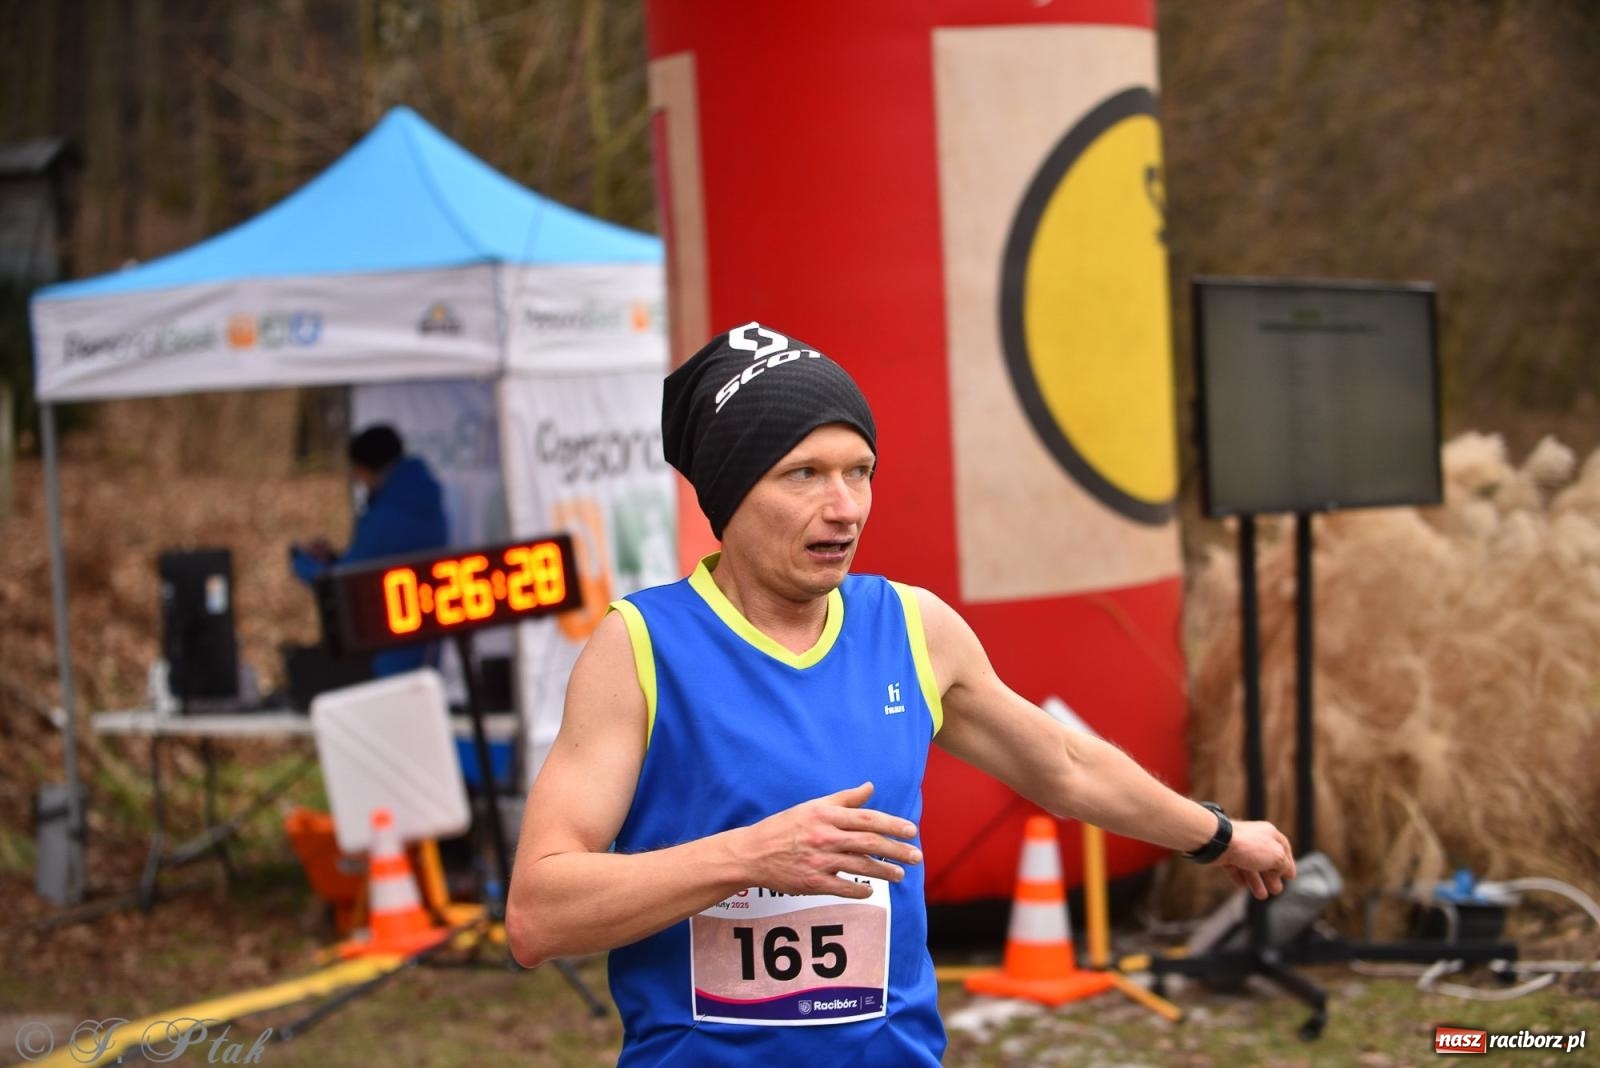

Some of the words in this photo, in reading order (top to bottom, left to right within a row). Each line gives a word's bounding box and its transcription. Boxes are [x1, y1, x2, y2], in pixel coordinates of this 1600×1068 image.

[383, 540, 567, 635] 0:26:28
[733, 924, 848, 982] 165
[813, 998, 858, 1011] Racibórz
